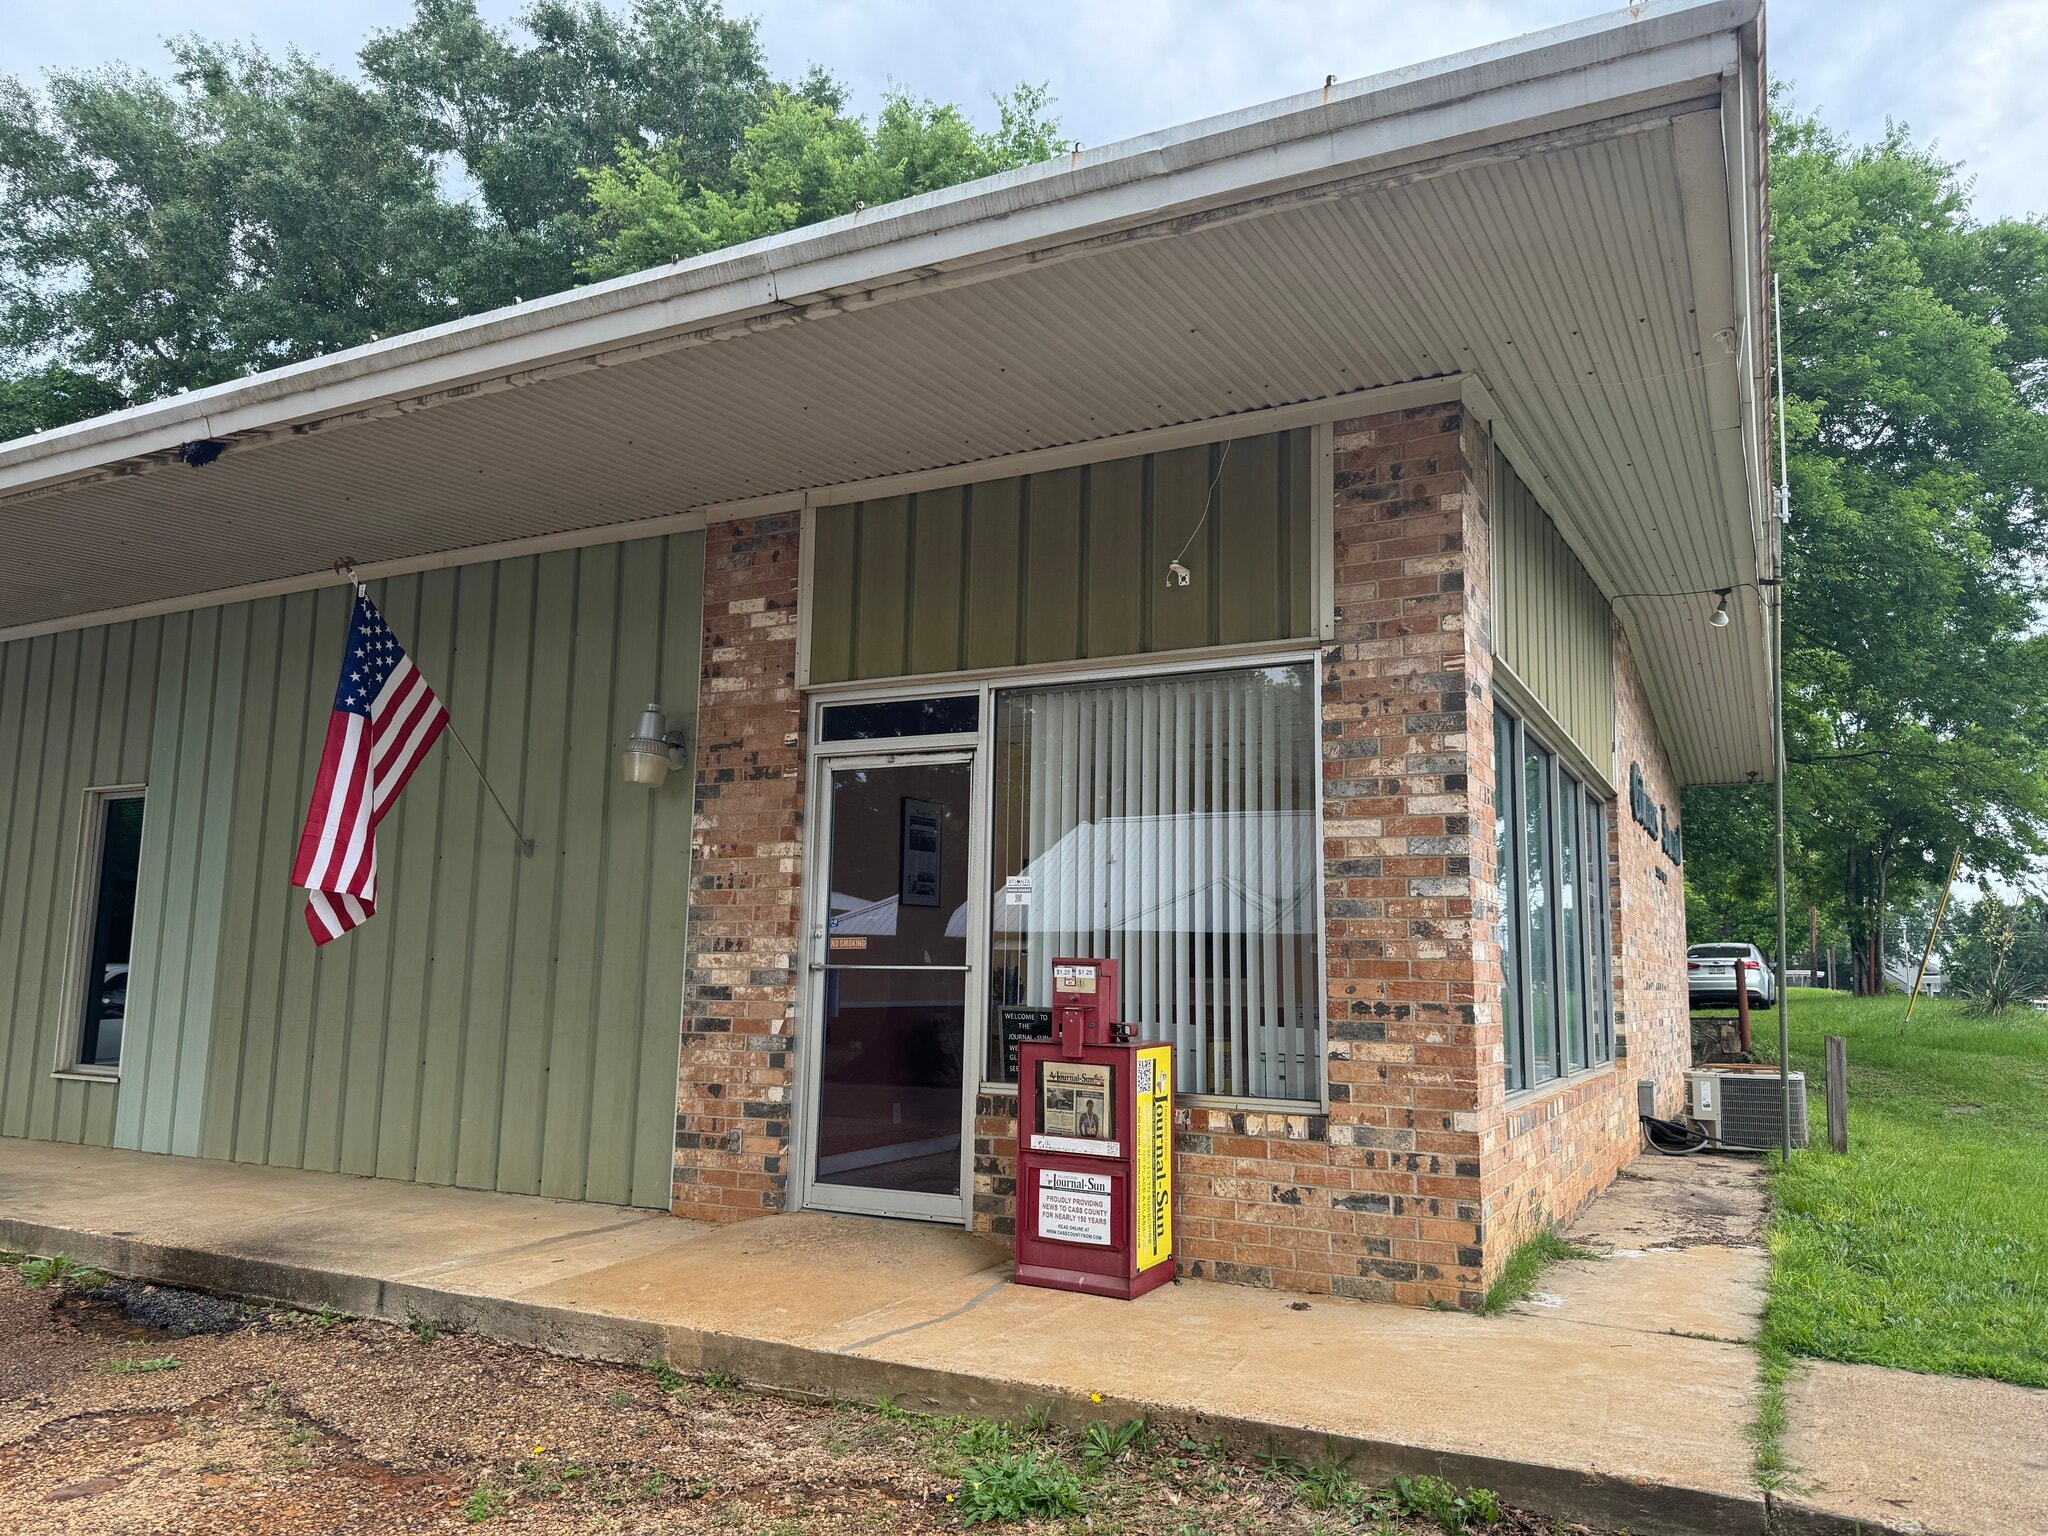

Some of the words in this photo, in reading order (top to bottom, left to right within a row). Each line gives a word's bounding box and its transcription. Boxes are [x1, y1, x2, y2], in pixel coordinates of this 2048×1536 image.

[832, 939, 840, 948] NO
[840, 939, 866, 948] SMOKING
[1004, 1012, 1035, 1021] WELCOME
[1018, 1022, 1031, 1030] THE
[1009, 1053, 1018, 1061] GL
[1153, 1094, 1169, 1238] Journal-Sun
[1053, 1173, 1105, 1191] Journal-Sun
[1046, 1195, 1071, 1204] PROUDLY
[1072, 1198, 1103, 1208] PROVIDING
[1042, 1203, 1058, 1211] NEWS
[1068, 1206, 1083, 1214] CASS
[1084, 1208, 1107, 1217] COUNTY
[1042, 1211, 1054, 1219] FOR
[1054, 1213, 1077, 1221] NEARLY
[1077, 1215, 1087, 1223] 150
[1088, 1217, 1107, 1225] YEARS
